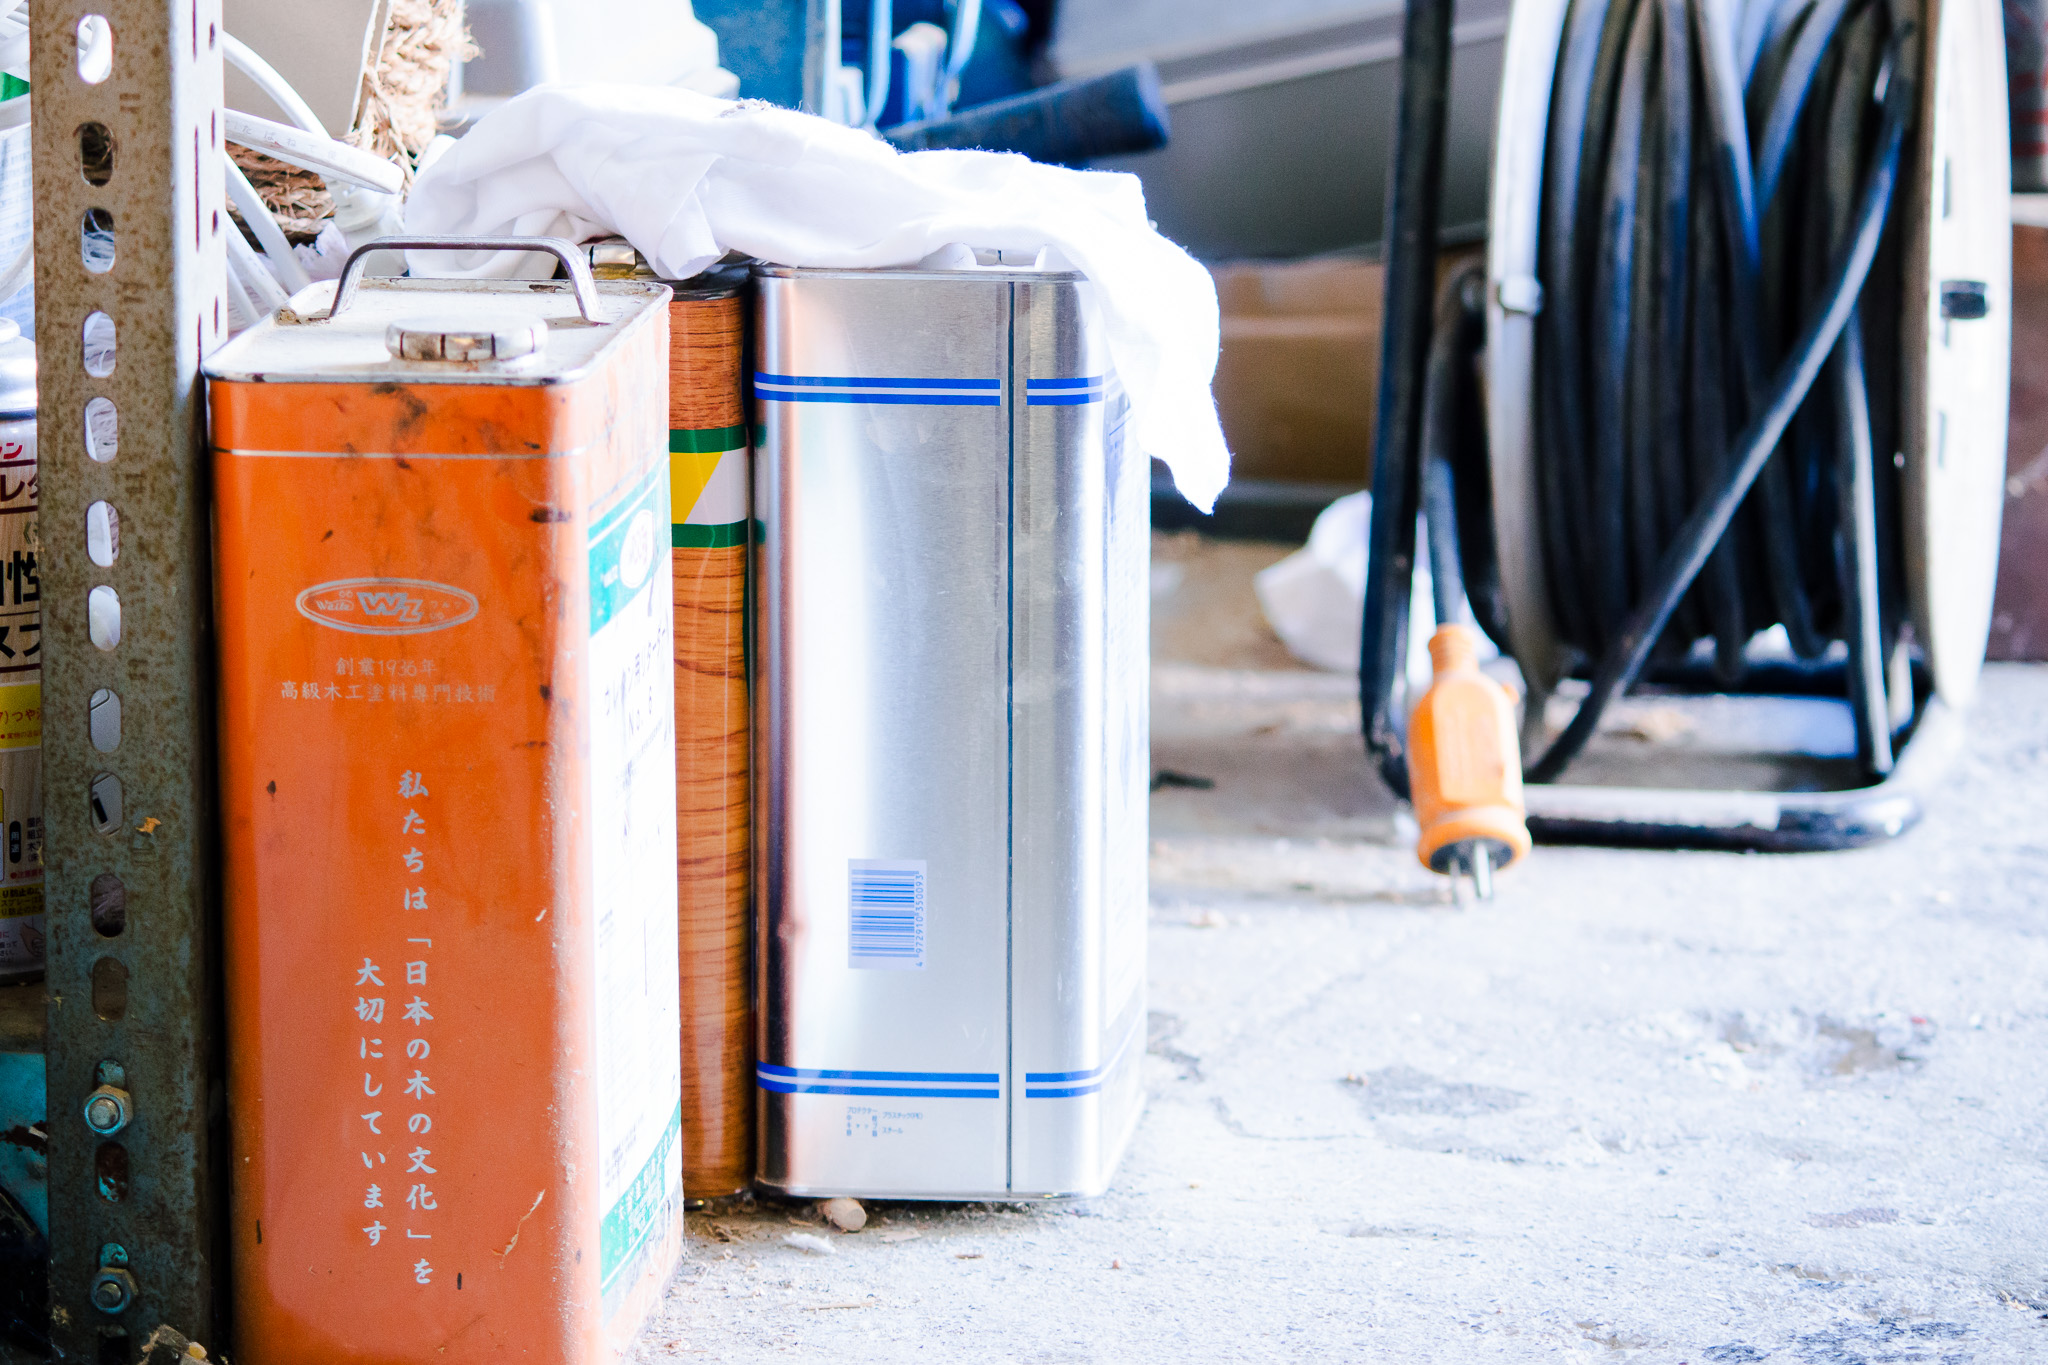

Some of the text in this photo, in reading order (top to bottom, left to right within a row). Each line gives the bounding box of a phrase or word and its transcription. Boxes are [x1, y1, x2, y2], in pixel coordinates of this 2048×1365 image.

[0, 442, 23, 459] ン
[0, 551, 40, 605] 性
[335, 657, 437, 677] 創業1936年
[397, 769, 438, 1285] 私たちは「日本の木の文化」を
[354, 957, 387, 1247] 大切にしています
